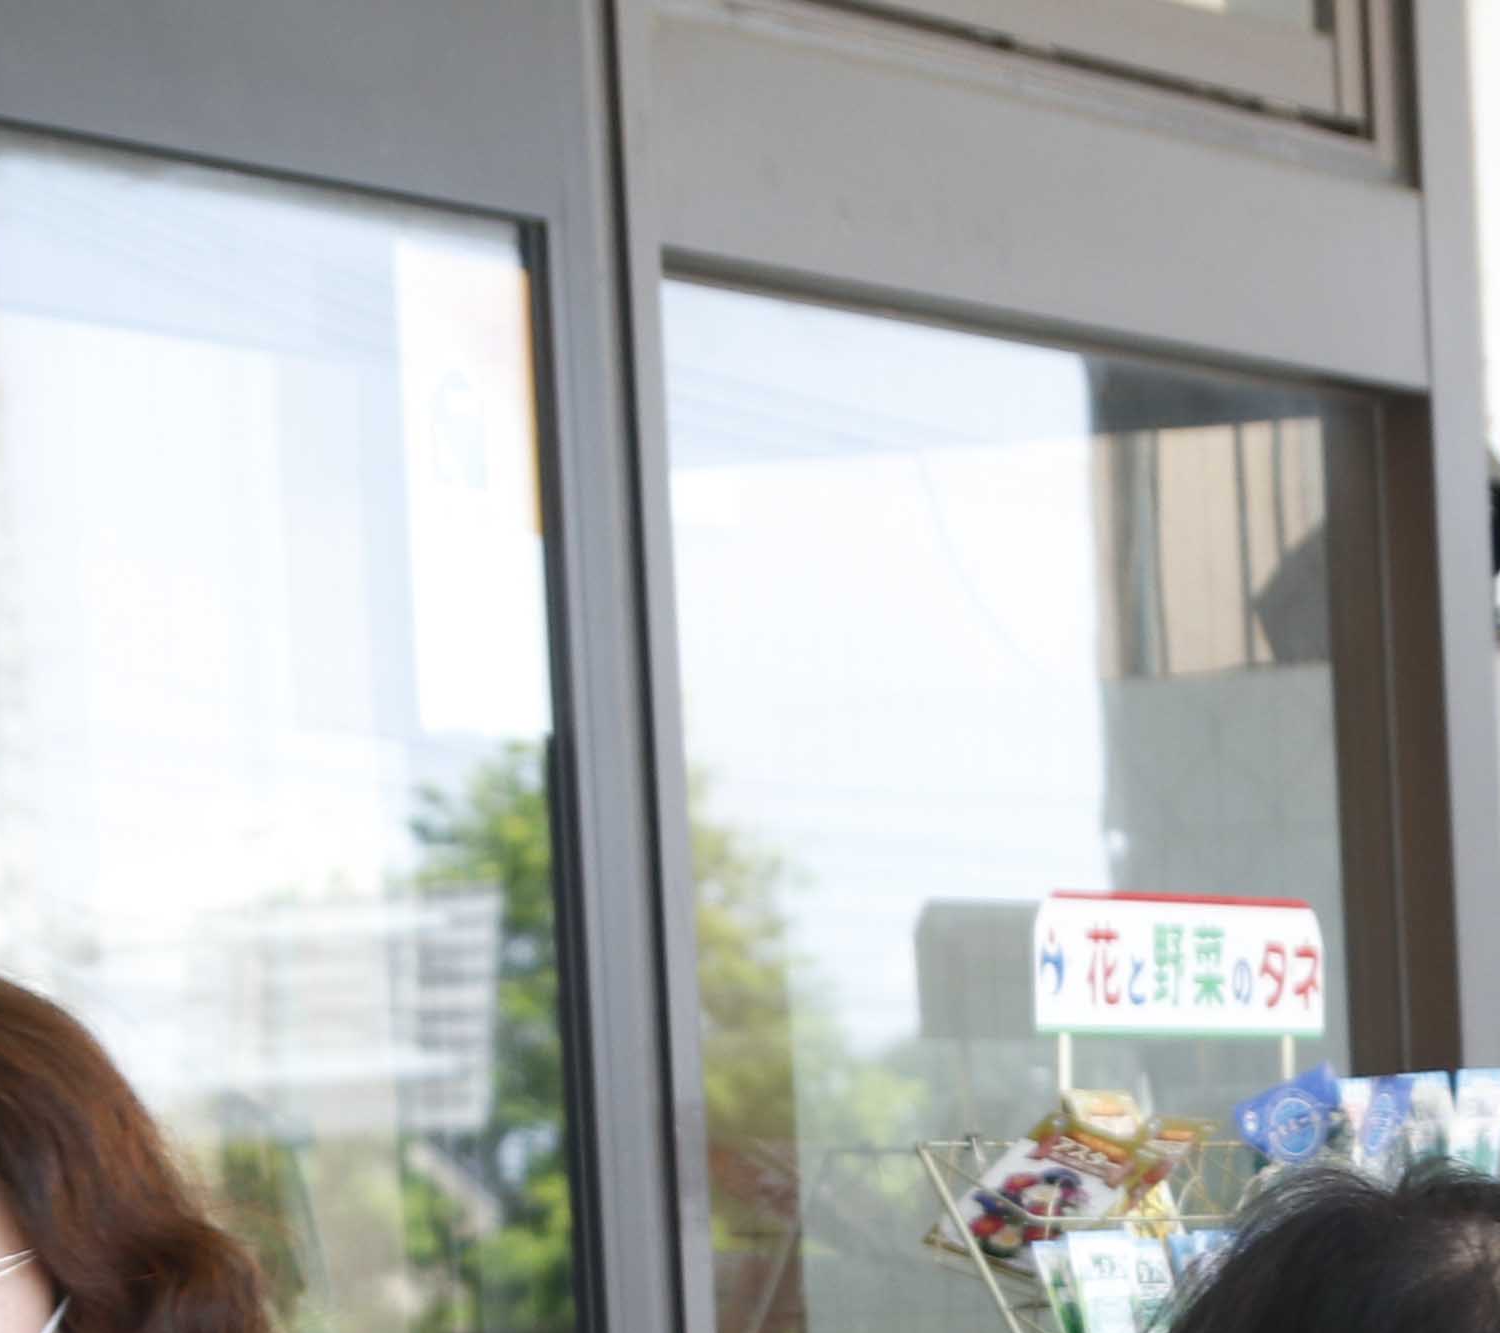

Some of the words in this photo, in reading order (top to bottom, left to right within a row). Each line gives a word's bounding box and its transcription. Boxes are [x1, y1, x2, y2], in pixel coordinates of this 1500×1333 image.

[1084, 920, 1320, 1010] 花と野菜のタネ
